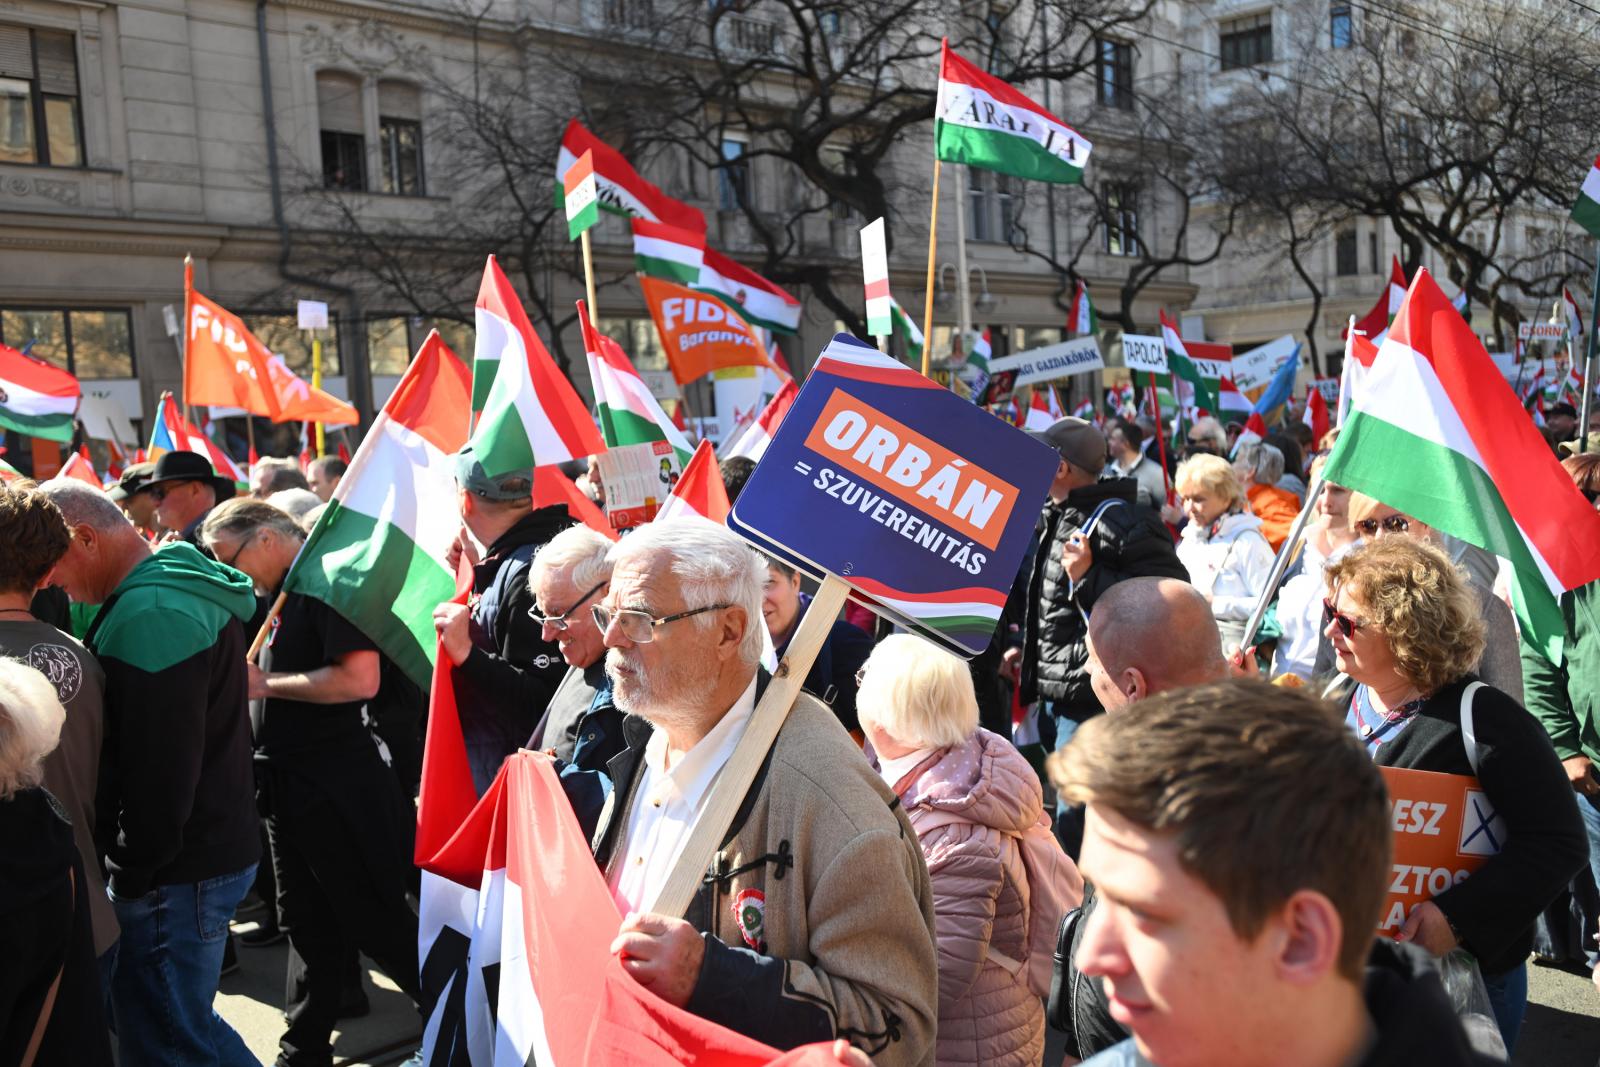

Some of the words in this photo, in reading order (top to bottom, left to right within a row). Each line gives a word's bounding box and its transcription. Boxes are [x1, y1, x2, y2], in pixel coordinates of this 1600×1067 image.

[1124, 340, 1165, 367] TAPOLCA
[823, 409, 1004, 530] ORBÁN
[813, 467, 987, 575] SZUVERENITÁS
[1390, 799, 1448, 836] ESZ
